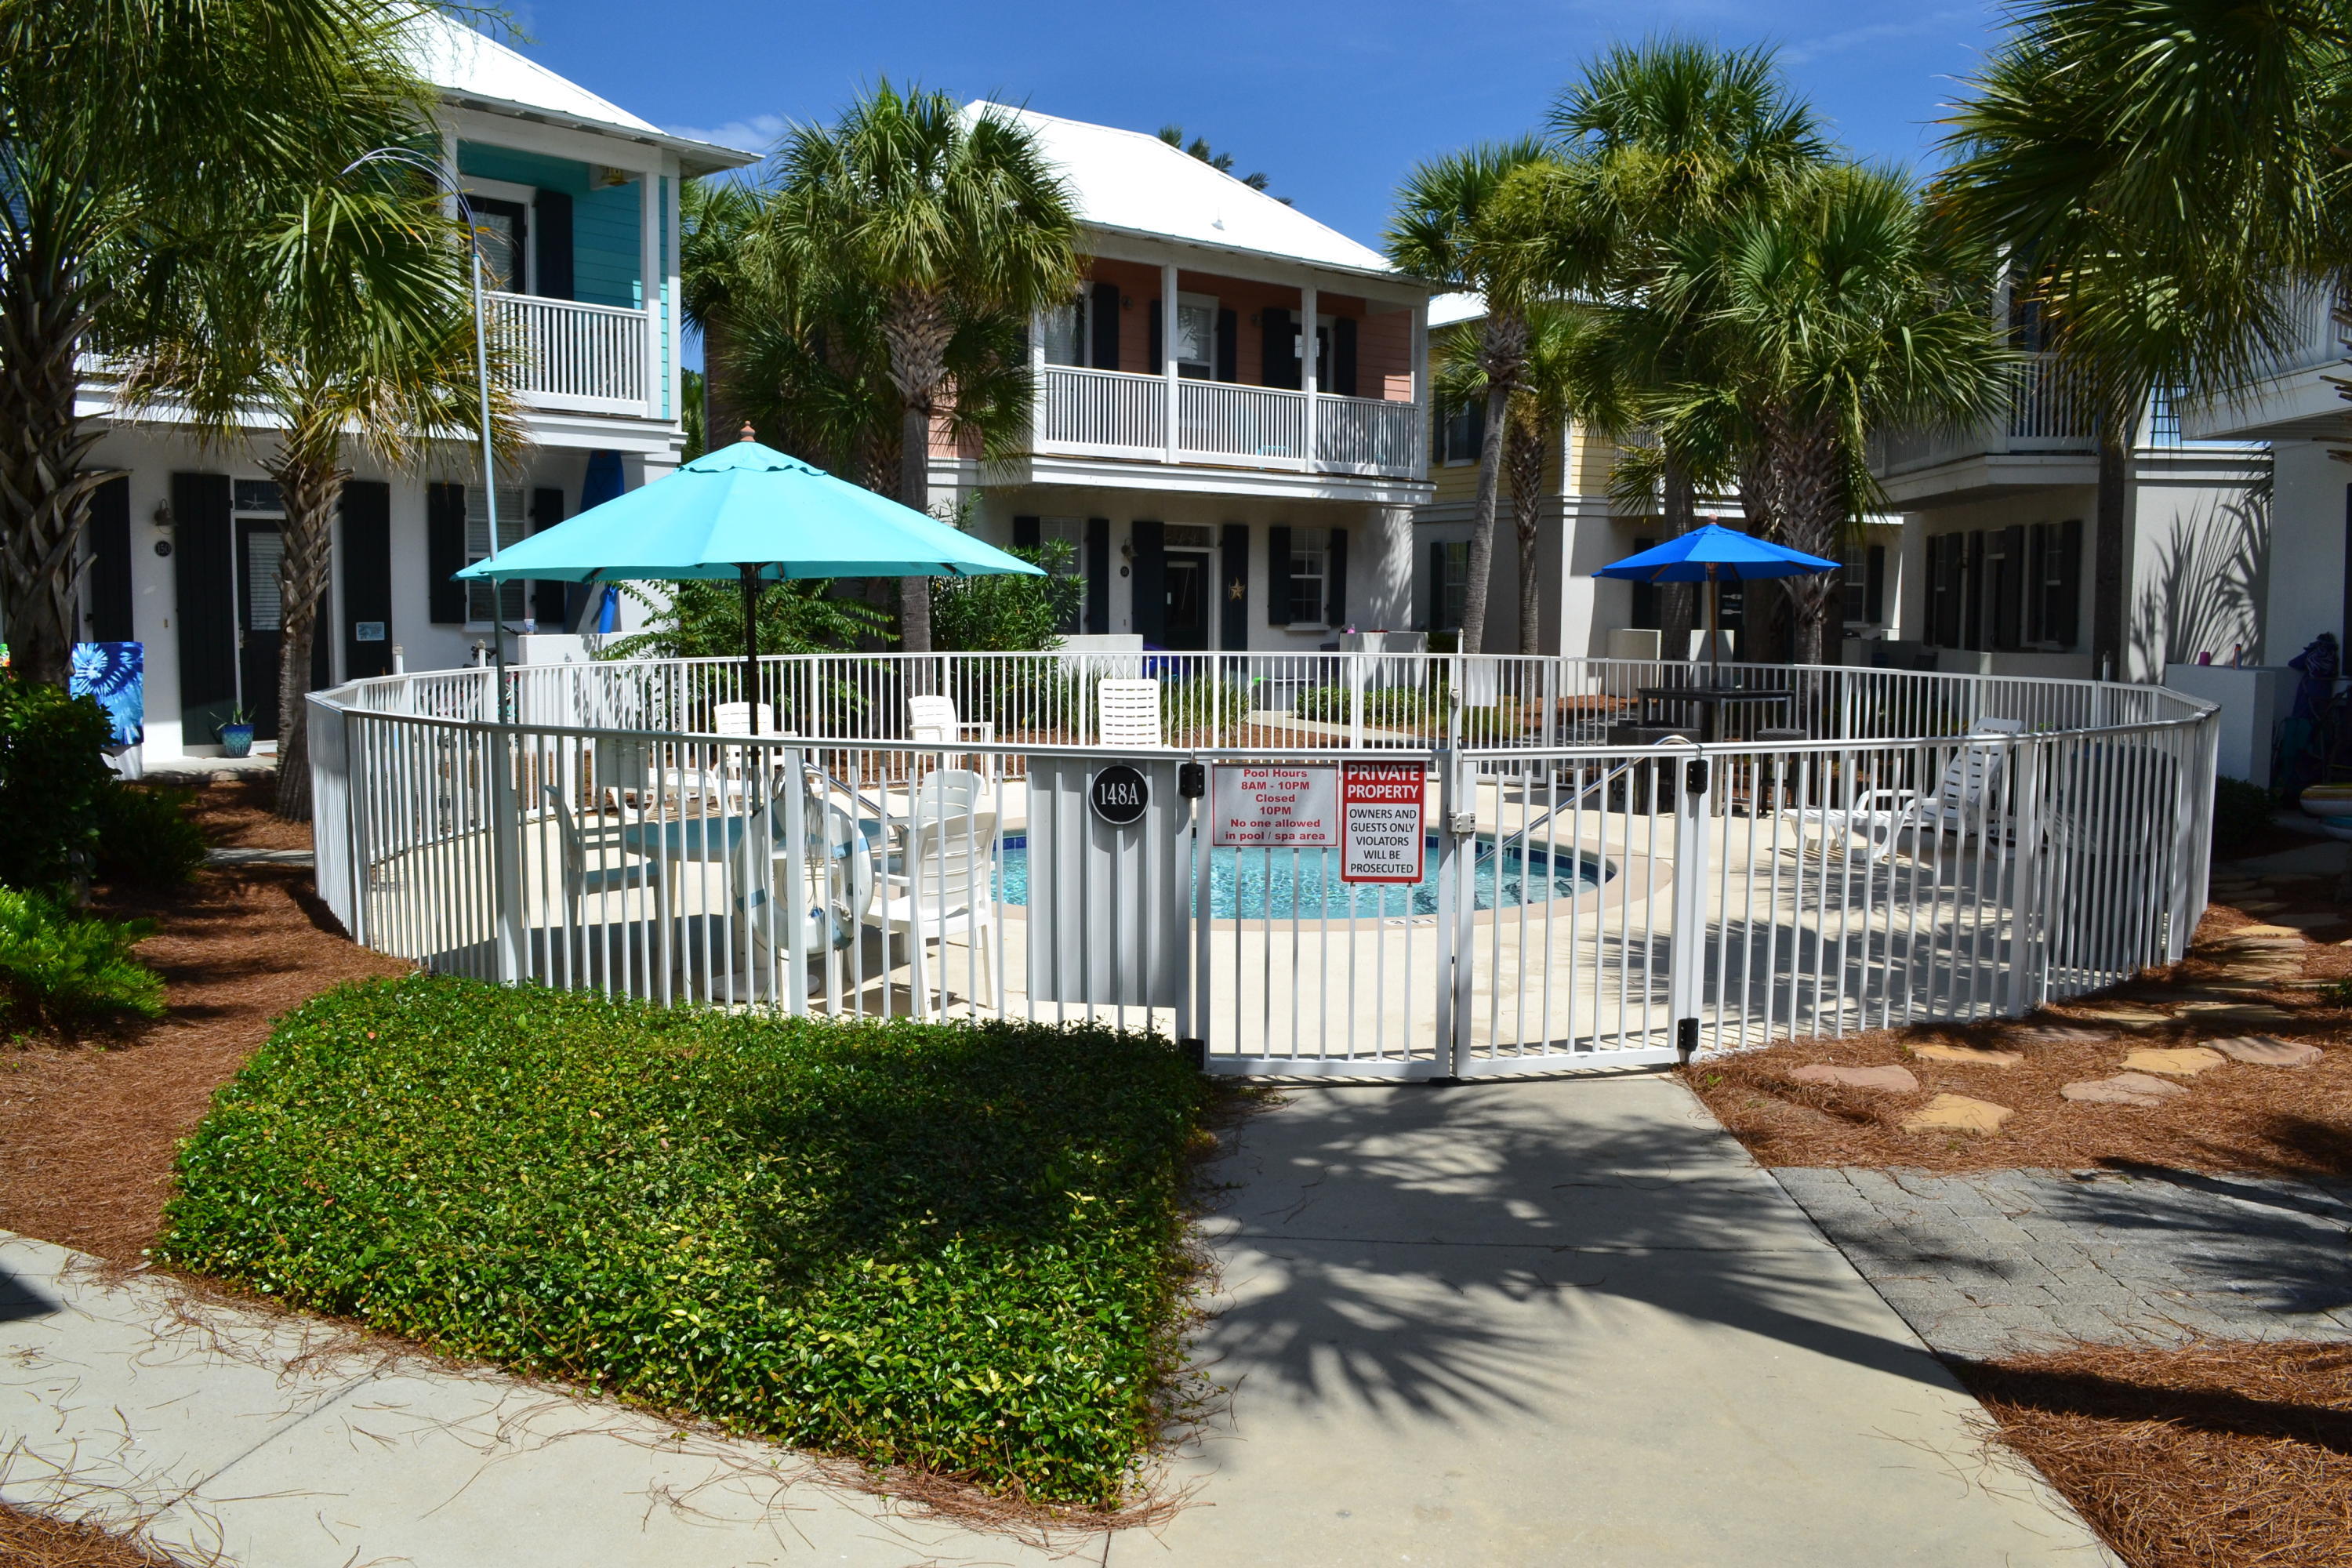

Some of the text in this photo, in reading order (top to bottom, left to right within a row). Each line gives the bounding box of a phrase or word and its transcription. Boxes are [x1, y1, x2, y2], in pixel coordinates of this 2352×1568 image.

[1243, 769, 1308, 778] Pool Hours
[1348, 764, 1420, 781] PRIVATE
[1241, 782, 1267, 790] 8AM
[1278, 782, 1309, 790] 10PM
[1100, 782, 1139, 805] 148A
[1348, 785, 1419, 799] PROPERTY
[1255, 794, 1295, 803] Closed
[1260, 807, 1291, 815] 10PM
[1349, 809, 1417, 819] OWNERS AND
[1275, 819, 1320, 828] allowed
[1351, 822, 1415, 833] GUESTS ONLY
[1225, 831, 1236, 840] in
[1240, 831, 1265, 841] pool
[1275, 833, 1294, 841] spa
[1356, 836, 1410, 846] VIOLATORS
[1363, 850, 1401, 859] WILL BE
[1350, 863, 1414, 873] PROSECUTED
